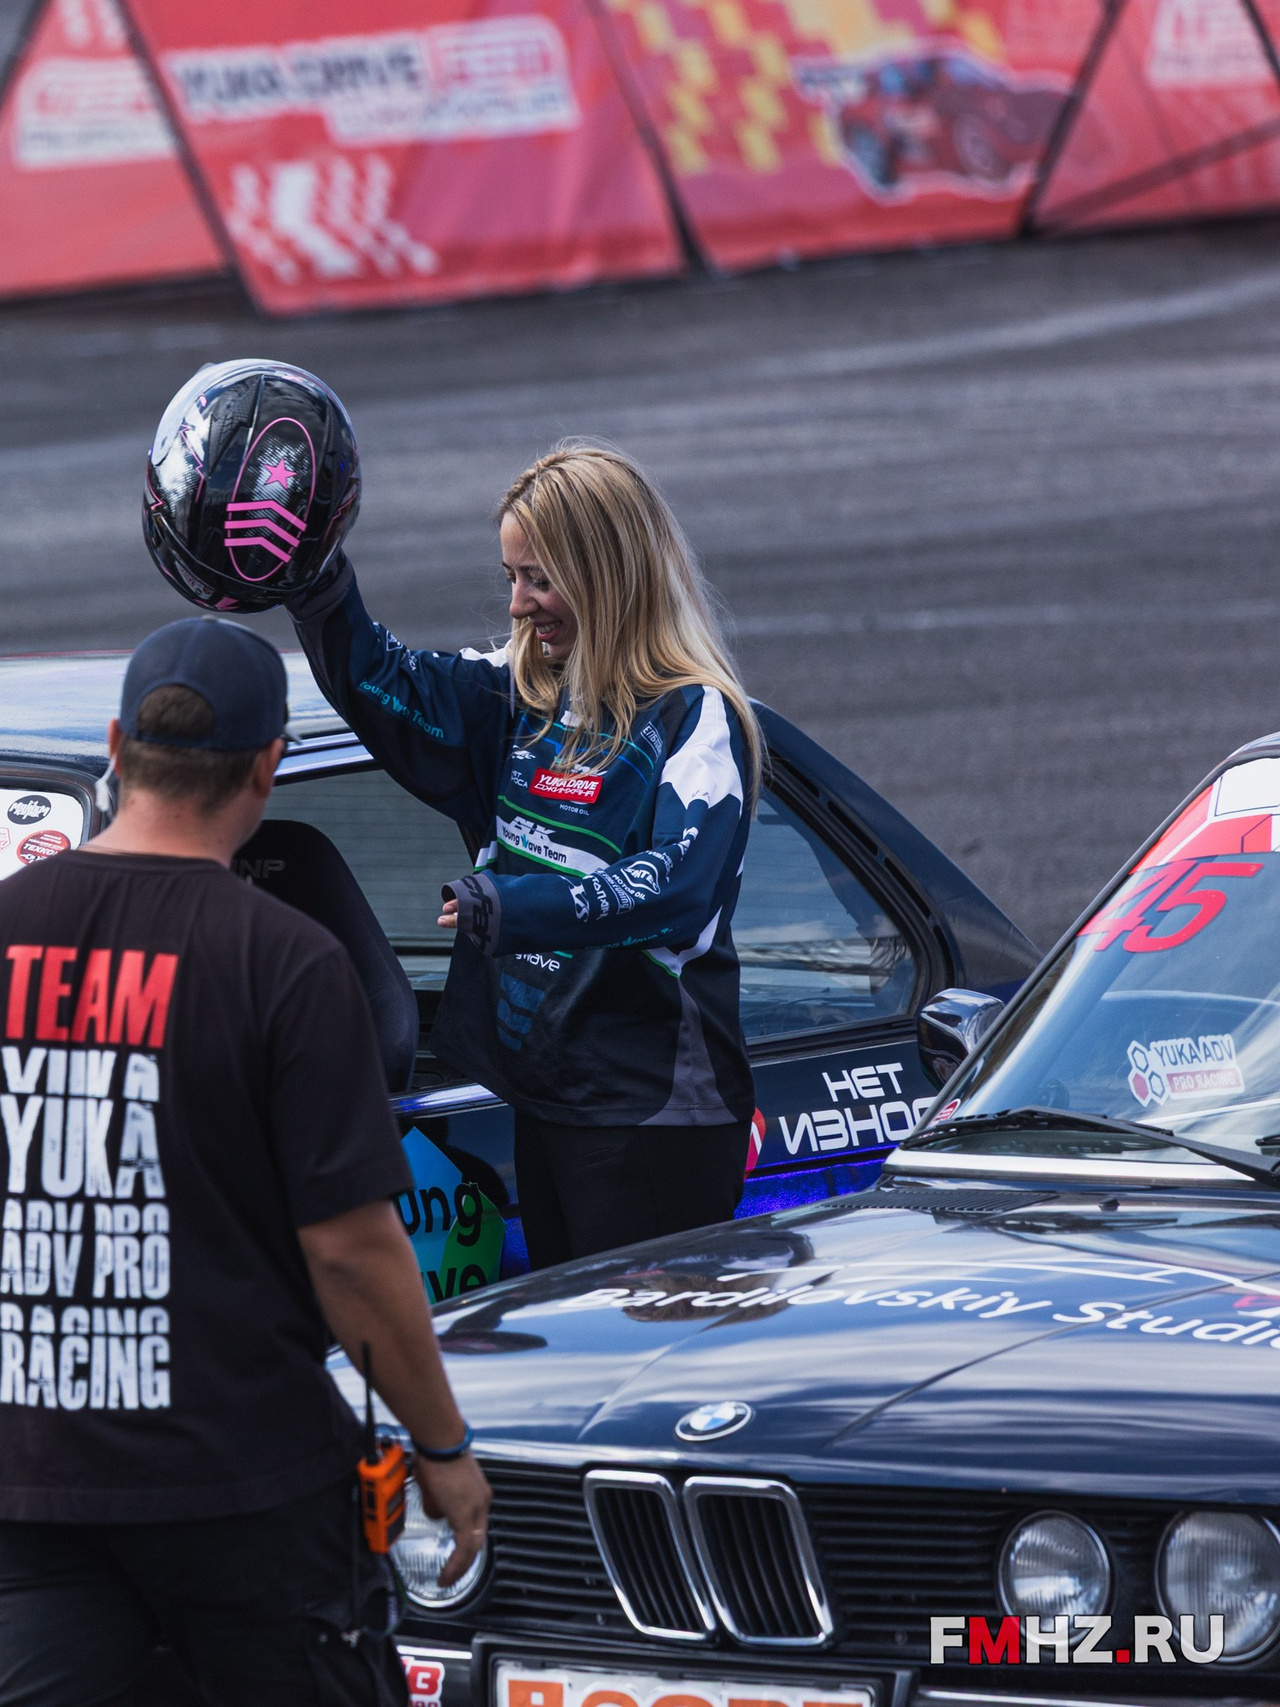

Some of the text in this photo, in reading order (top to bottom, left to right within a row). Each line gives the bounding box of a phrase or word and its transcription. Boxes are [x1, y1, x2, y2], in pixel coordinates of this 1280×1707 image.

[412, 709, 445, 738] Team
[540, 774, 600, 791] YUKA DRIVE
[559, 804, 590, 816] MOTOR OIL
[23, 843, 58, 856] ТЕХКО
[501, 825, 521, 847] Young
[543, 845, 567, 864] Team
[612, 874, 646, 901] MOTOR OIL
[1076, 860, 1264, 953] 45
[5, 945, 178, 1048] TEAM
[1154, 1039, 1233, 1067] YUKA ADV
[822, 1063, 903, 1102] НЕТ
[1173, 1071, 1236, 1091] PRO RACING
[0, 1096, 166, 1198] YUKA
[394, 1183, 483, 1246] ung
[0, 1231, 170, 1300] ADV PRO
[421, 1264, 488, 1303] ve
[558, 1286, 1280, 1350] Bardilovskiy Studi
[0, 1332, 171, 1409] RACING
